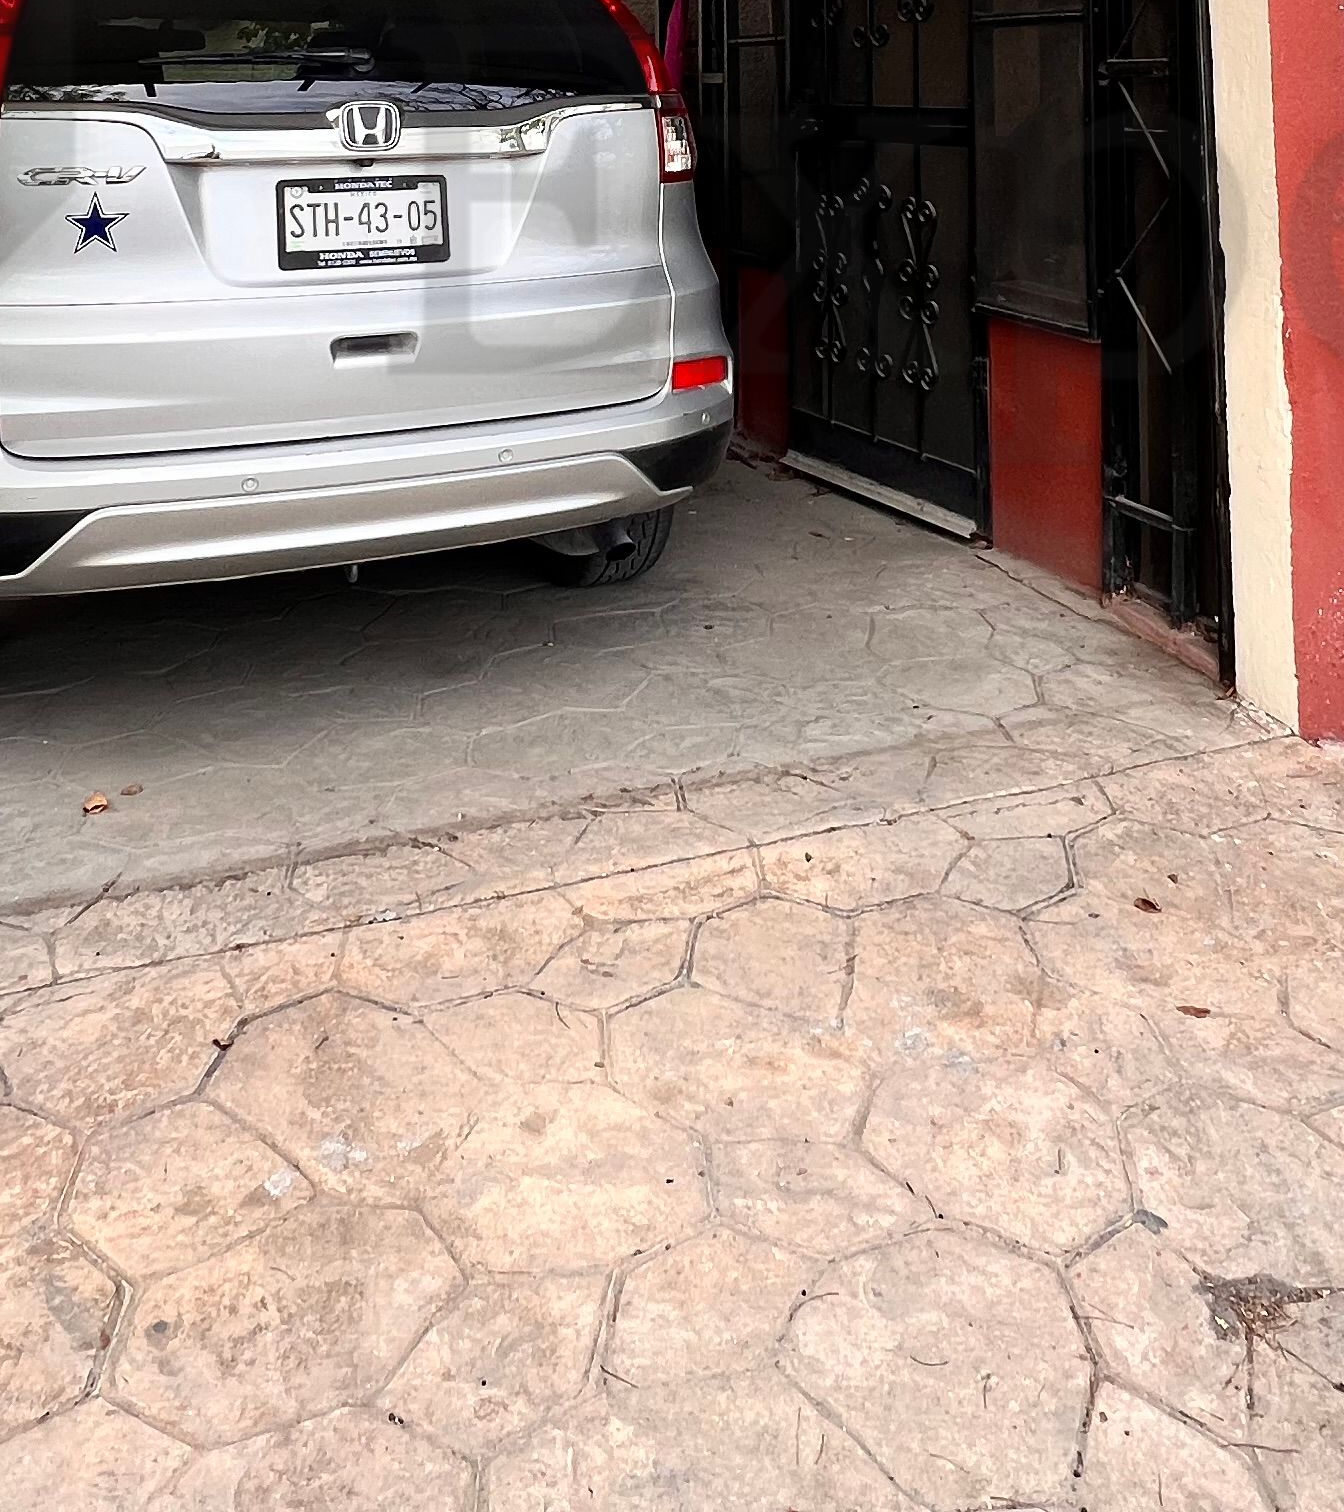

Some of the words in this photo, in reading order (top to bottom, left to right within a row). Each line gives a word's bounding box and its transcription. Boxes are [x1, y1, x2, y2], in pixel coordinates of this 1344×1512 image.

[16, 165, 147, 186] CR-V
[289, 199, 438, 239] STH-43-05
[319, 250, 365, 260] HONDA
